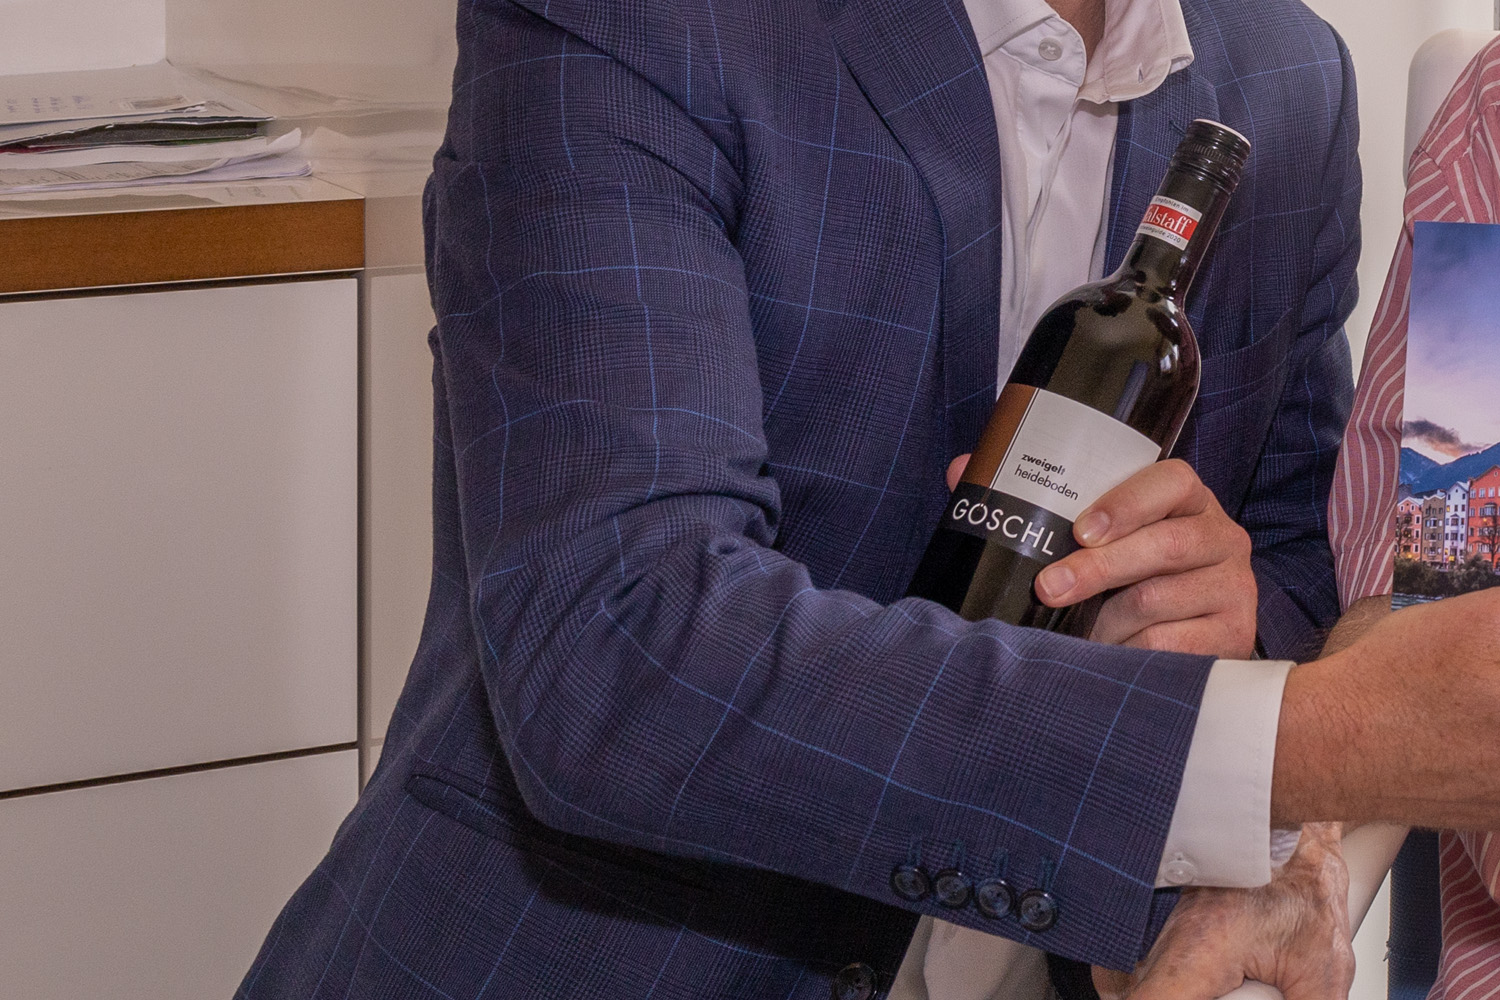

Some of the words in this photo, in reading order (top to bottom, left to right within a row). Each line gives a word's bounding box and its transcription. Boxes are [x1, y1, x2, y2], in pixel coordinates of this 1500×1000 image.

[1166, 231, 1181, 243] 2020
[1021, 453, 1066, 475] zweigelt
[1014, 464, 1079, 501] heideboden
[952, 498, 1055, 556] GÖSCHL
